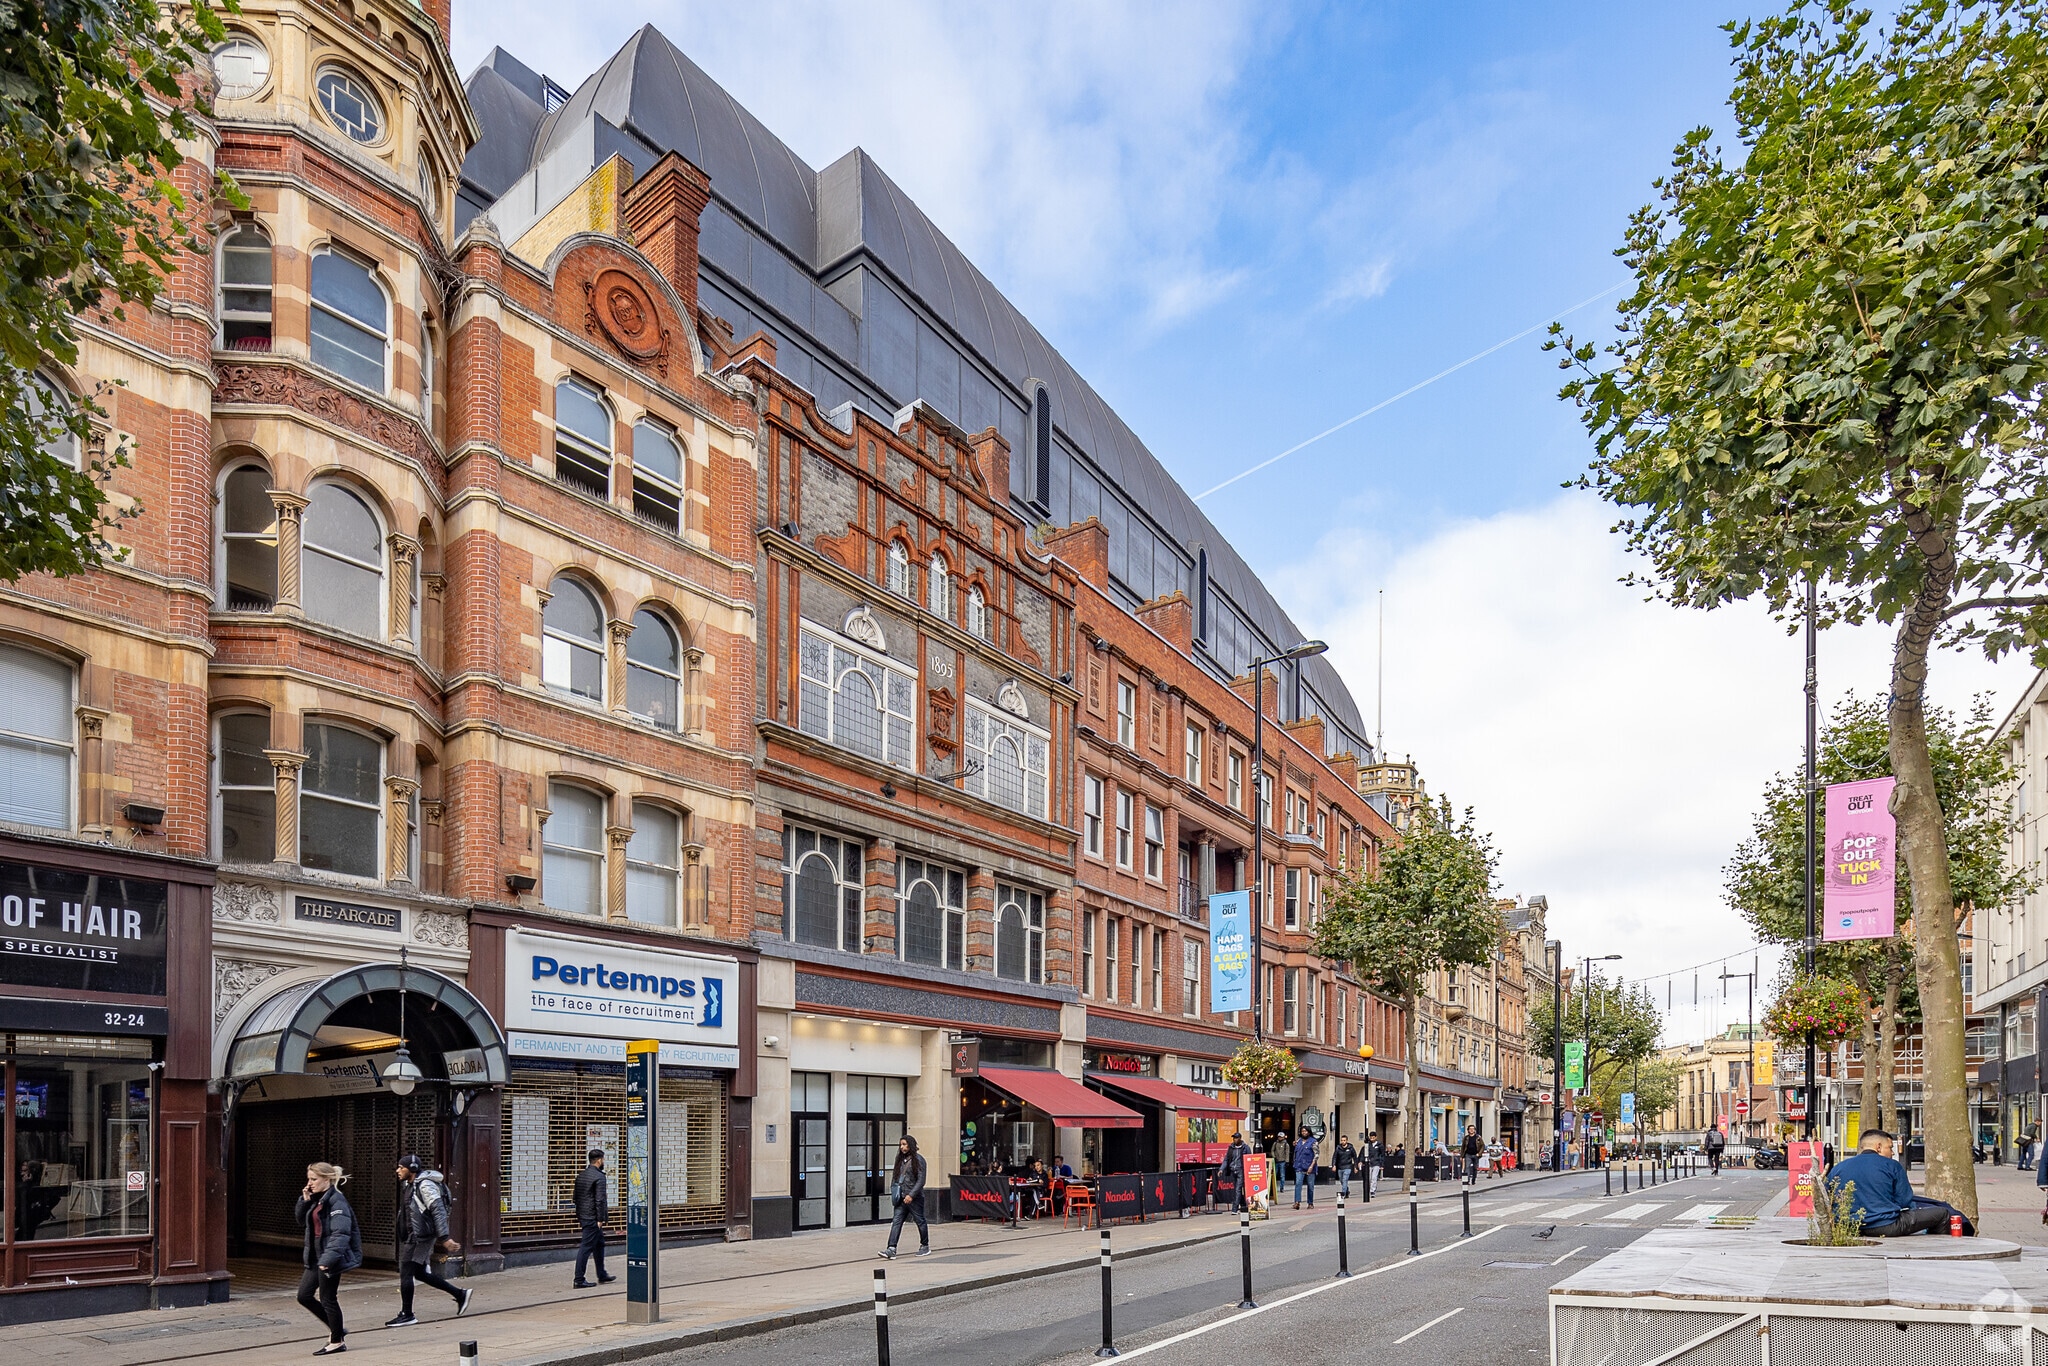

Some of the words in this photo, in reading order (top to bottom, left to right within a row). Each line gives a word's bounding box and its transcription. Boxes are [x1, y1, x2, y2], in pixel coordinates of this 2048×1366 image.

[931, 656, 953, 678] 1895
[1848, 794, 1873, 803] TREAT
[1847, 801, 1873, 811] OUT
[1843, 836, 1876, 850] POP
[1843, 849, 1876, 861] OUT
[1838, 860, 1881, 875] TUCK
[1851, 874, 1868, 885] IN
[3, 895, 46, 928] OF
[62, 902, 142, 940] HAIR
[1217, 934, 1244, 944] HAND
[5, 940, 118, 960] SPECIALIST
[1218, 944, 1243, 954] BAGS
[1222, 951, 1248, 961] GLAD
[1218, 961, 1244, 972] RAGS
[532, 955, 696, 1000] Pertemps
[531, 994, 555, 1007] the
[562, 996, 592, 1011] face
[599, 998, 613, 1013] of
[618, 1004, 695, 1021] recruitment
[105, 1012, 145, 1027] 32-24
[514, 1039, 582, 1054] PERMANENT
[585, 1043, 608, 1055] AND
[674, 1049, 736, 1063] RECRUITMENT
[1105, 1056, 1142, 1073] Nando's
[323, 1065, 369, 1079] Pertemps
[959, 1189, 1003, 1204] Nando's
[1105, 1190, 1136, 1204] Nando's
